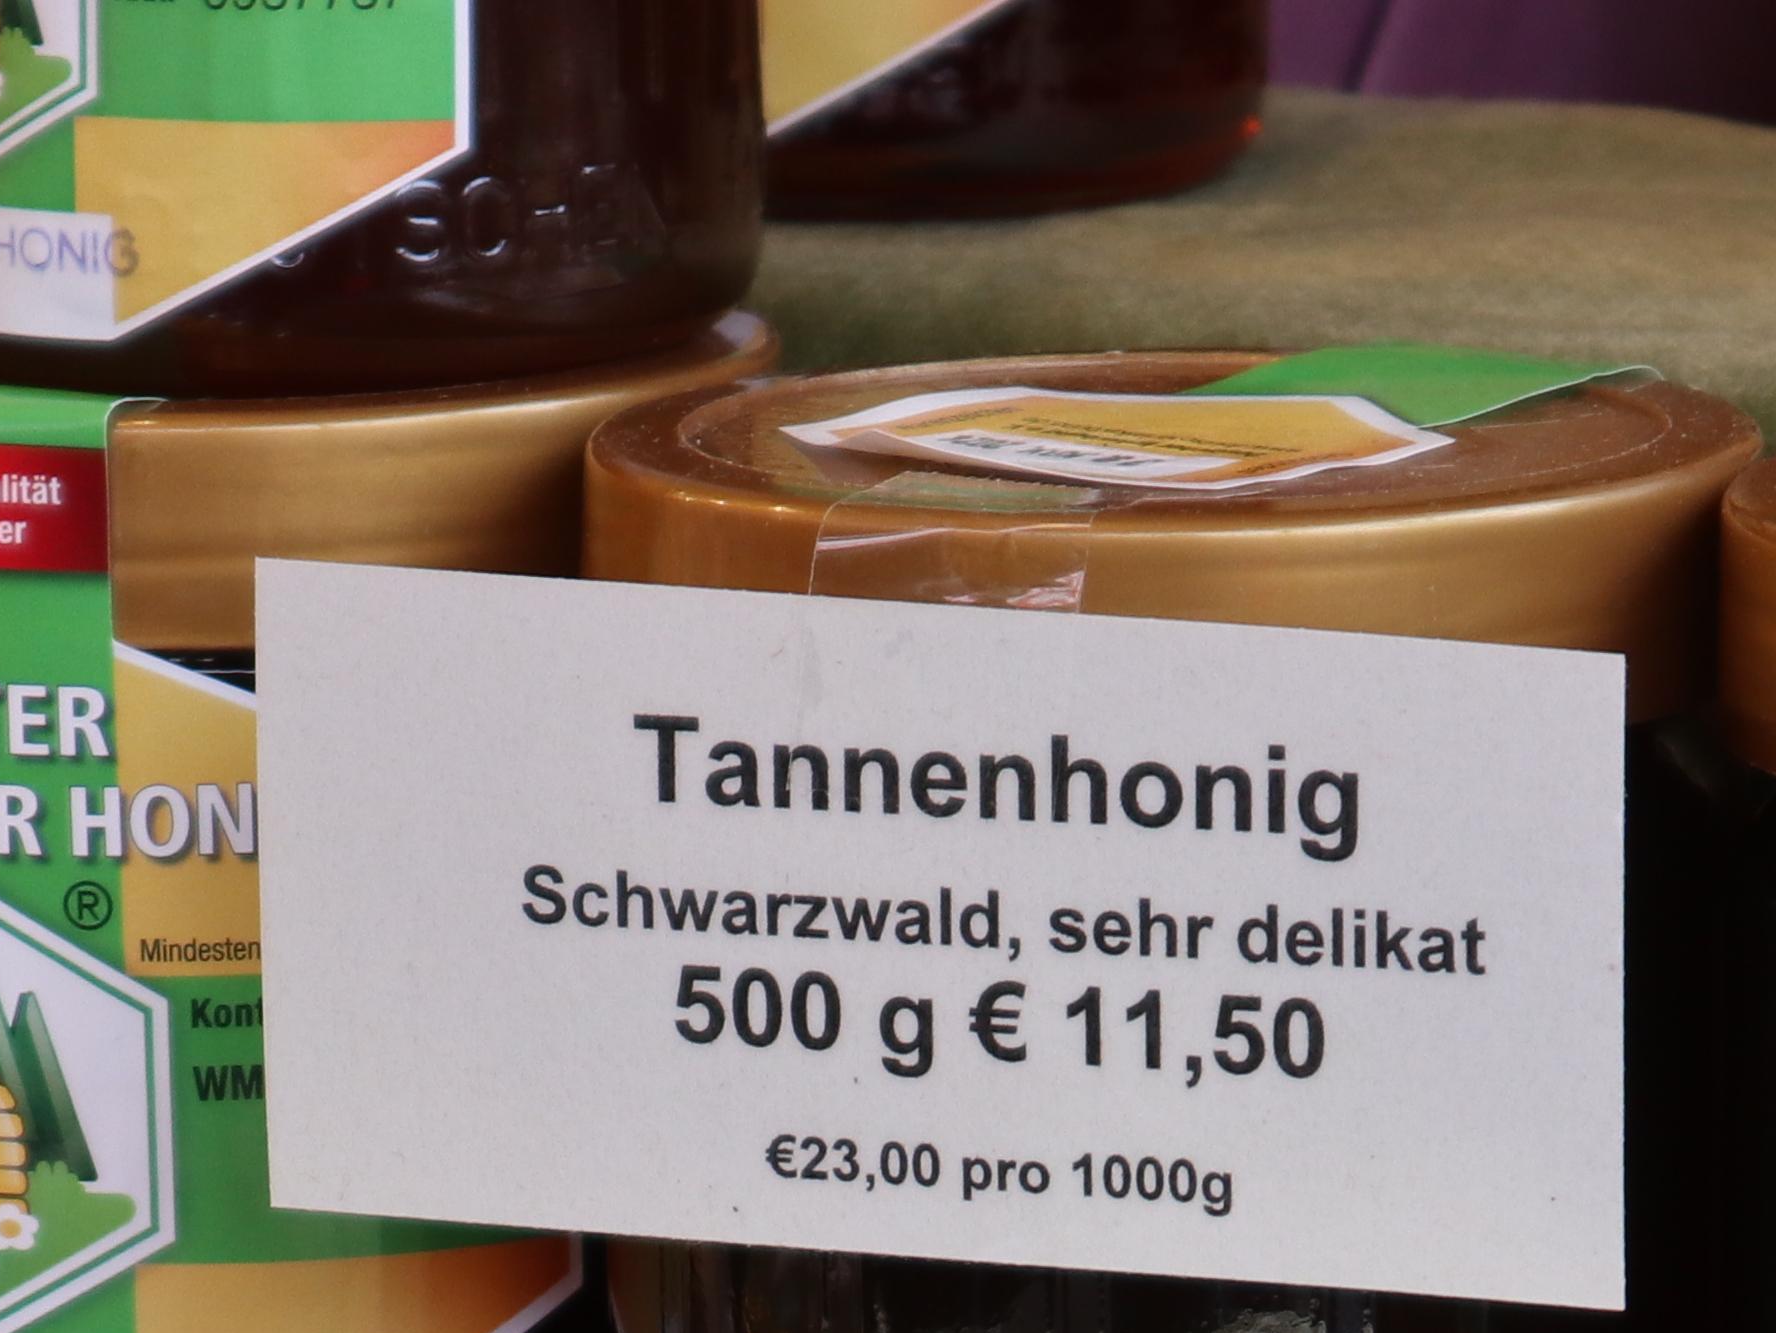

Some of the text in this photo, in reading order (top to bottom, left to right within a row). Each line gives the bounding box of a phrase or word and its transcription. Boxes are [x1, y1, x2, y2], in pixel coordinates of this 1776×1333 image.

[70, 781, 258, 860] HON
[633, 712, 1361, 863] Tannenhonig
[139, 937, 261, 966] Mindesten
[522, 863, 1488, 977] Schwarzwald, sehr delikat
[674, 963, 1327, 1088] 500 g € 11,50
[765, 1131, 1236, 1217] €23,00 pro 1000g
